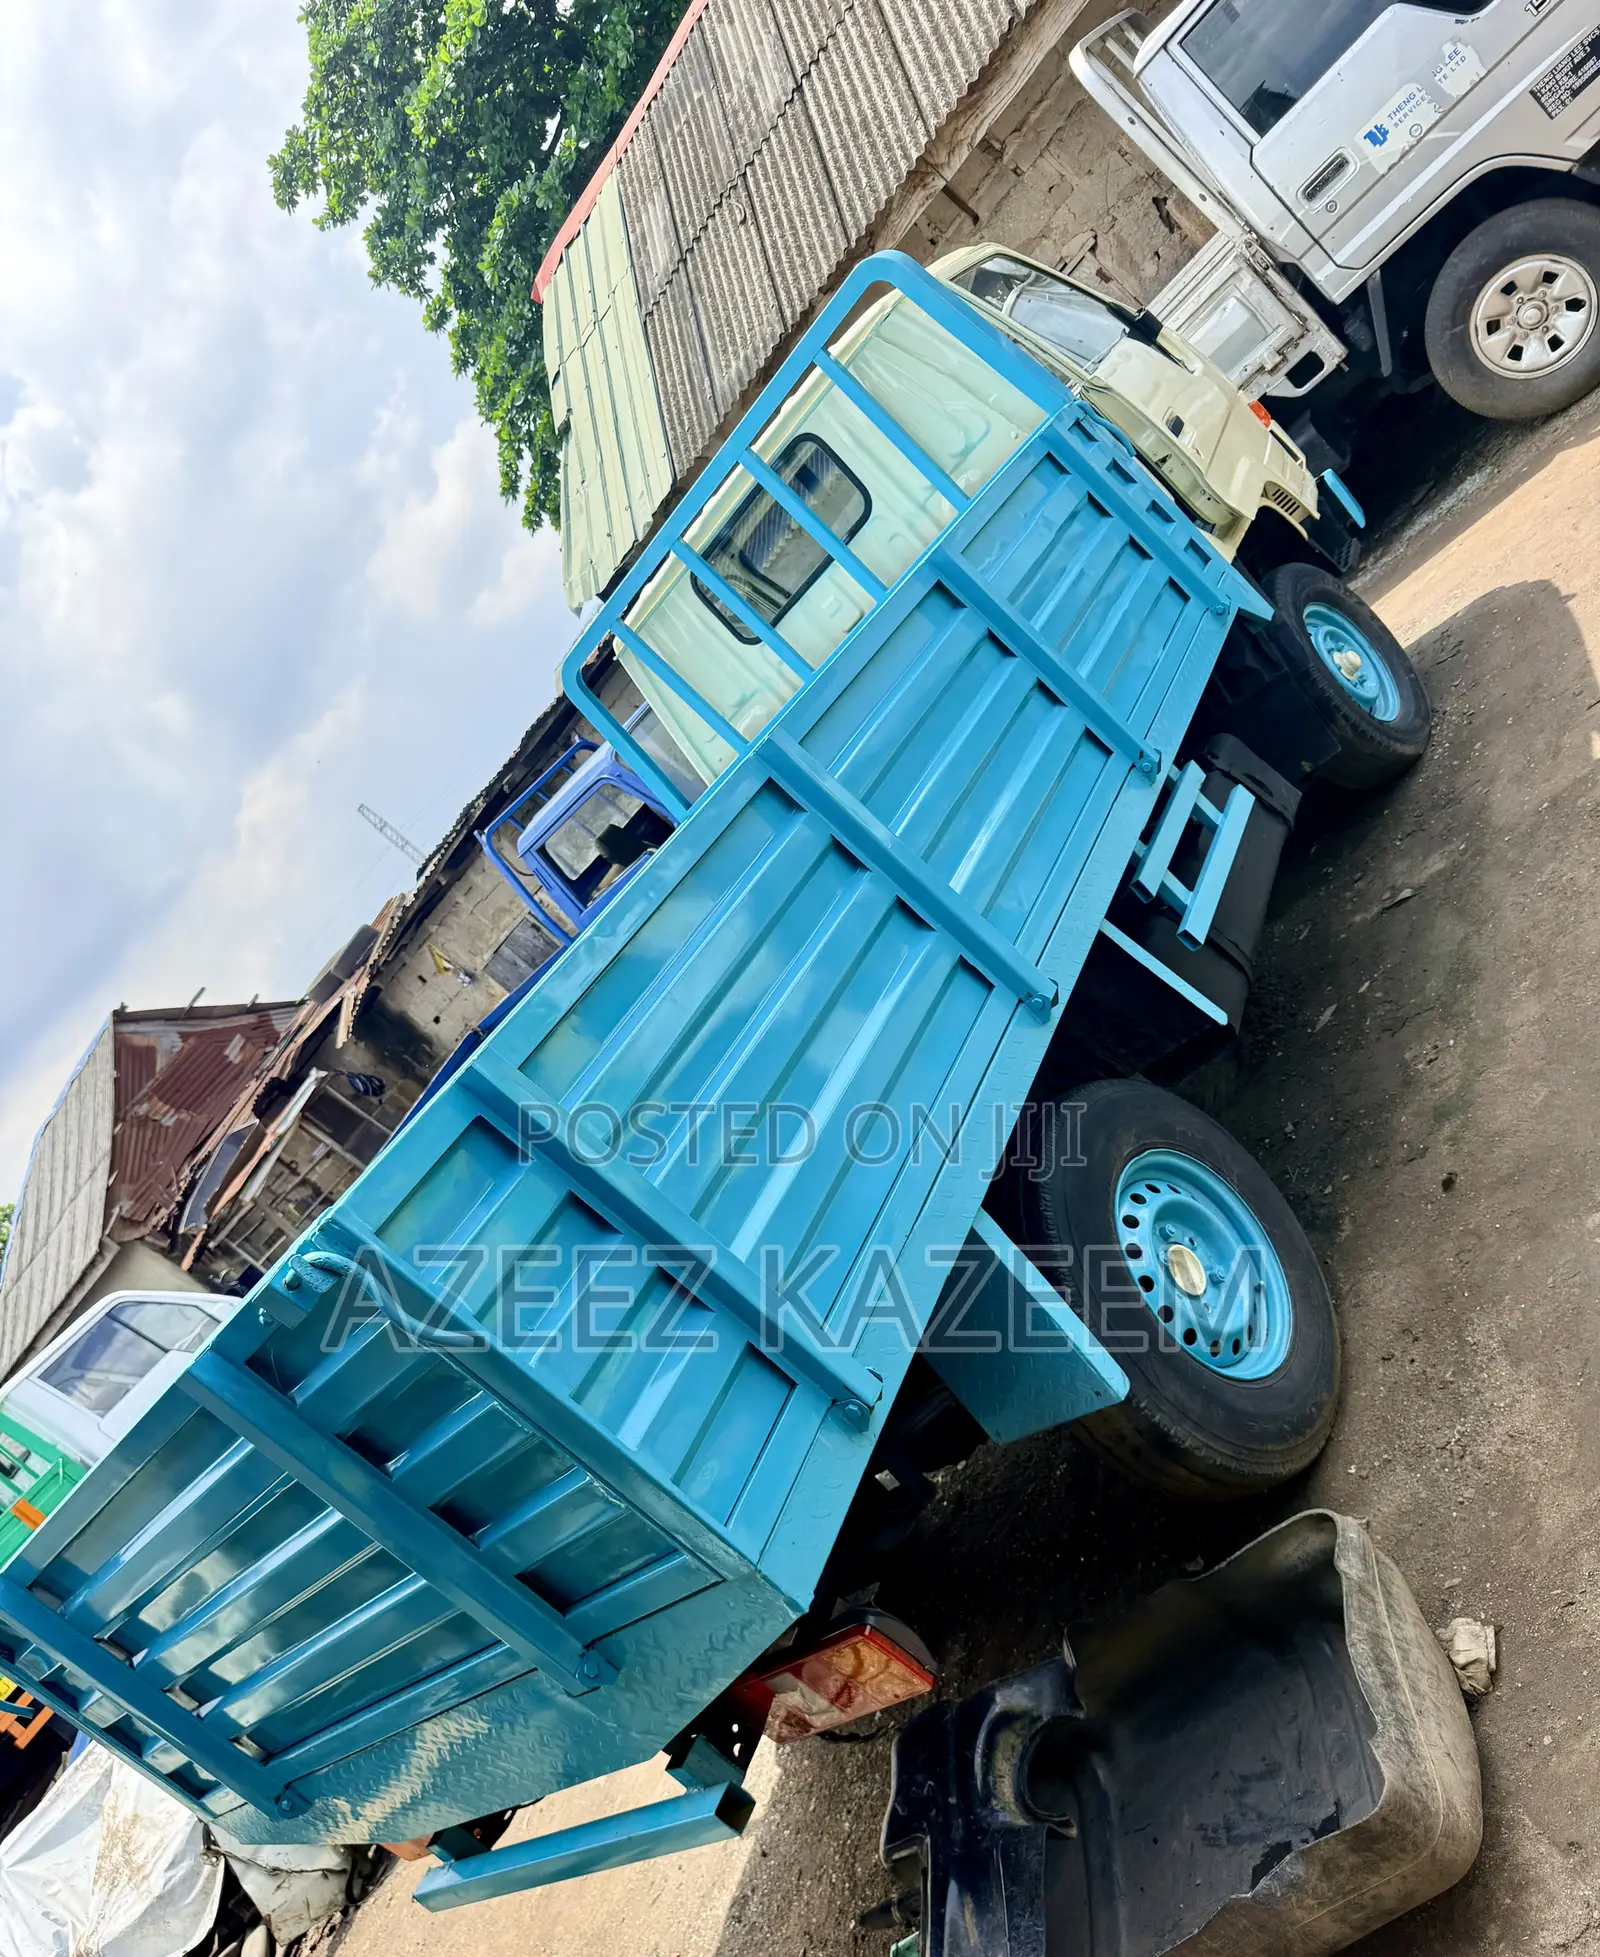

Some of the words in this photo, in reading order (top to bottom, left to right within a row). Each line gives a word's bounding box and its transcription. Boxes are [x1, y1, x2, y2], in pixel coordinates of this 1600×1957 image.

[1450, 55, 1466, 72] LTD
[1532, 72, 1553, 92] THENG
[1552, 55, 1572, 74] LIANG
[1570, 43, 1584, 57] LEE
[1541, 78, 1556, 94] KAKI
[1555, 61, 1573, 80] BUKIT
[1573, 50, 1586, 64] AVE
[1544, 74, 1578, 108] SINGAPORE
[1558, 71, 1573, 86] KB-1
[1387, 92, 1416, 120] THENG
[1547, 99, 1561, 112] REG
